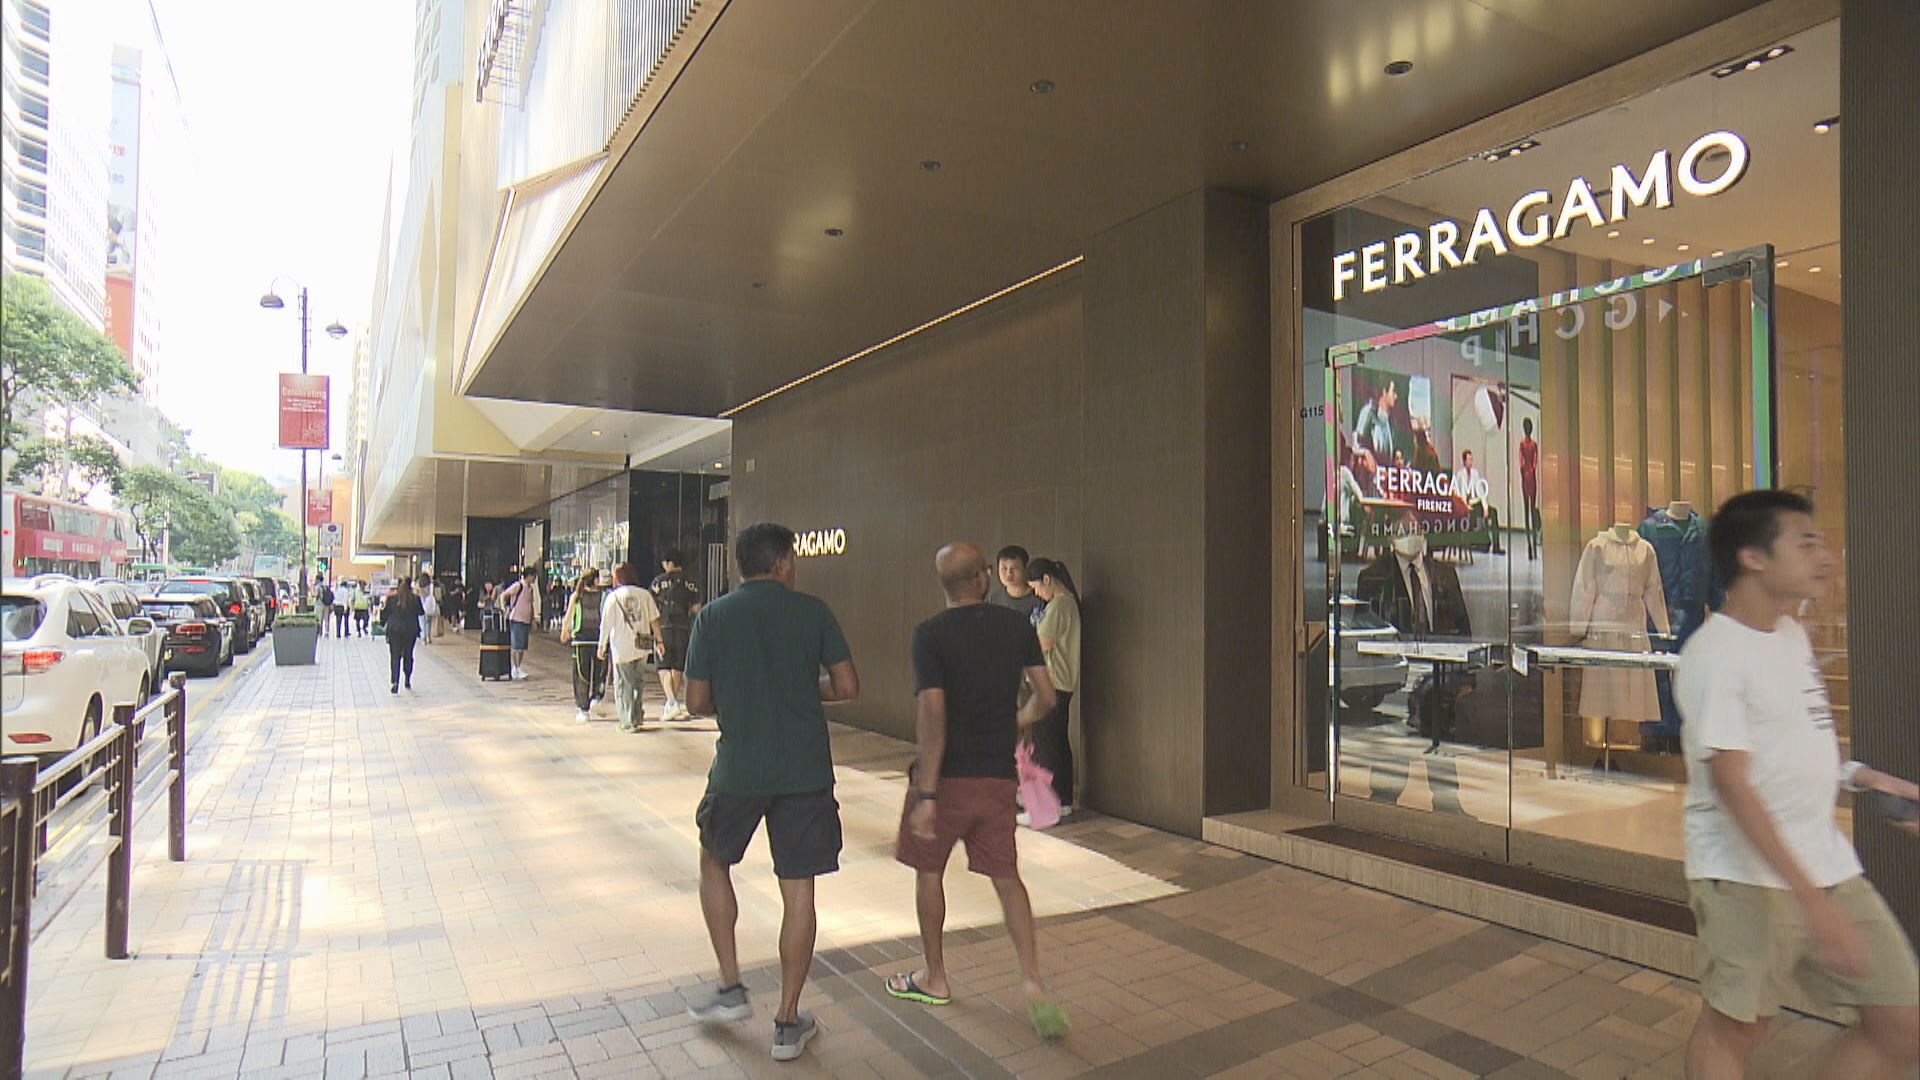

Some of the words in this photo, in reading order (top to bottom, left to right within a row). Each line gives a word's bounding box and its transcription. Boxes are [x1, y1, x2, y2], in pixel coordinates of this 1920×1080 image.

[1332, 130, 1750, 301] FERRAGAMO
[1300, 405, 1324, 419] G115
[1377, 466, 1489, 498] FERRAGAMO
[1417, 498, 1453, 513] FIRENZE
[793, 529, 847, 556] RAGAMO
